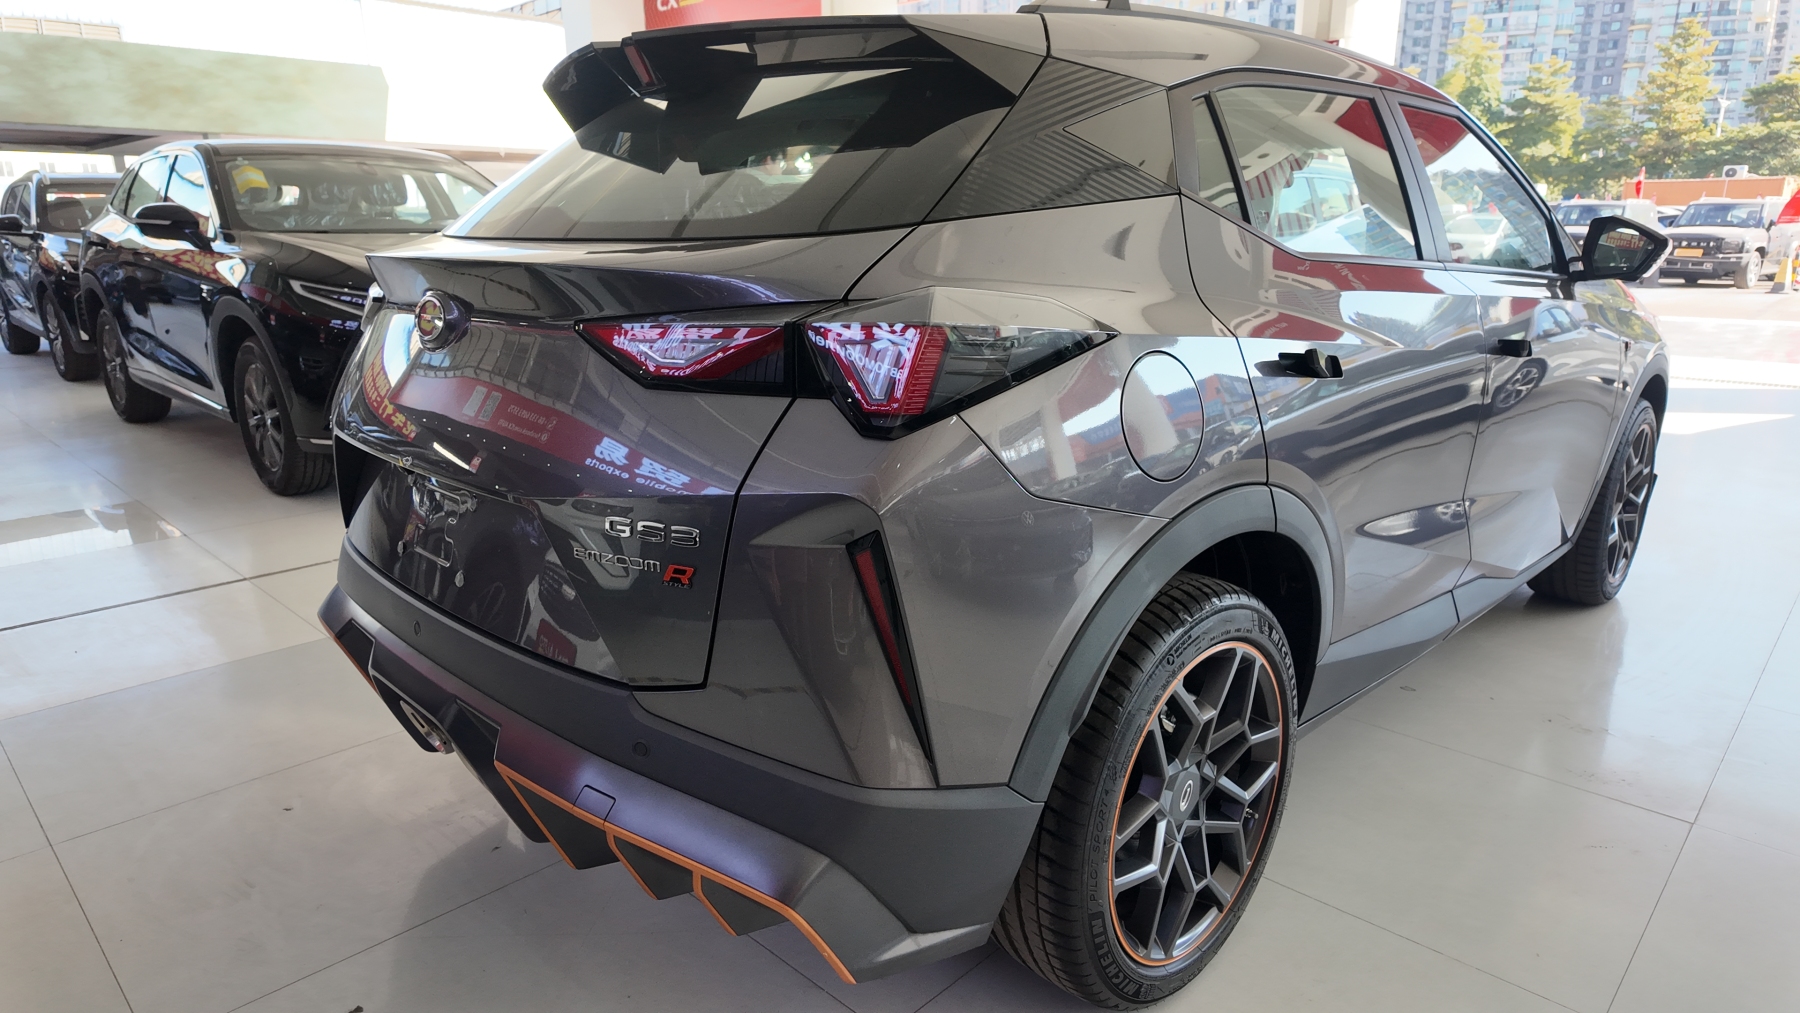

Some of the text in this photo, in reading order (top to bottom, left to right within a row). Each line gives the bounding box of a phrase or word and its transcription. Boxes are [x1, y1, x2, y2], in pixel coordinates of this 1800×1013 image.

[605, 516, 700, 548] GS3
[662, 564, 695, 584] R
[662, 580, 690, 590] STYLE
[1271, 628, 1298, 713] MICHELIN
[1092, 796, 1108, 854] SPORT
[1089, 858, 1099, 902] PILOT
[1091, 917, 1140, 996] MICHELIN
